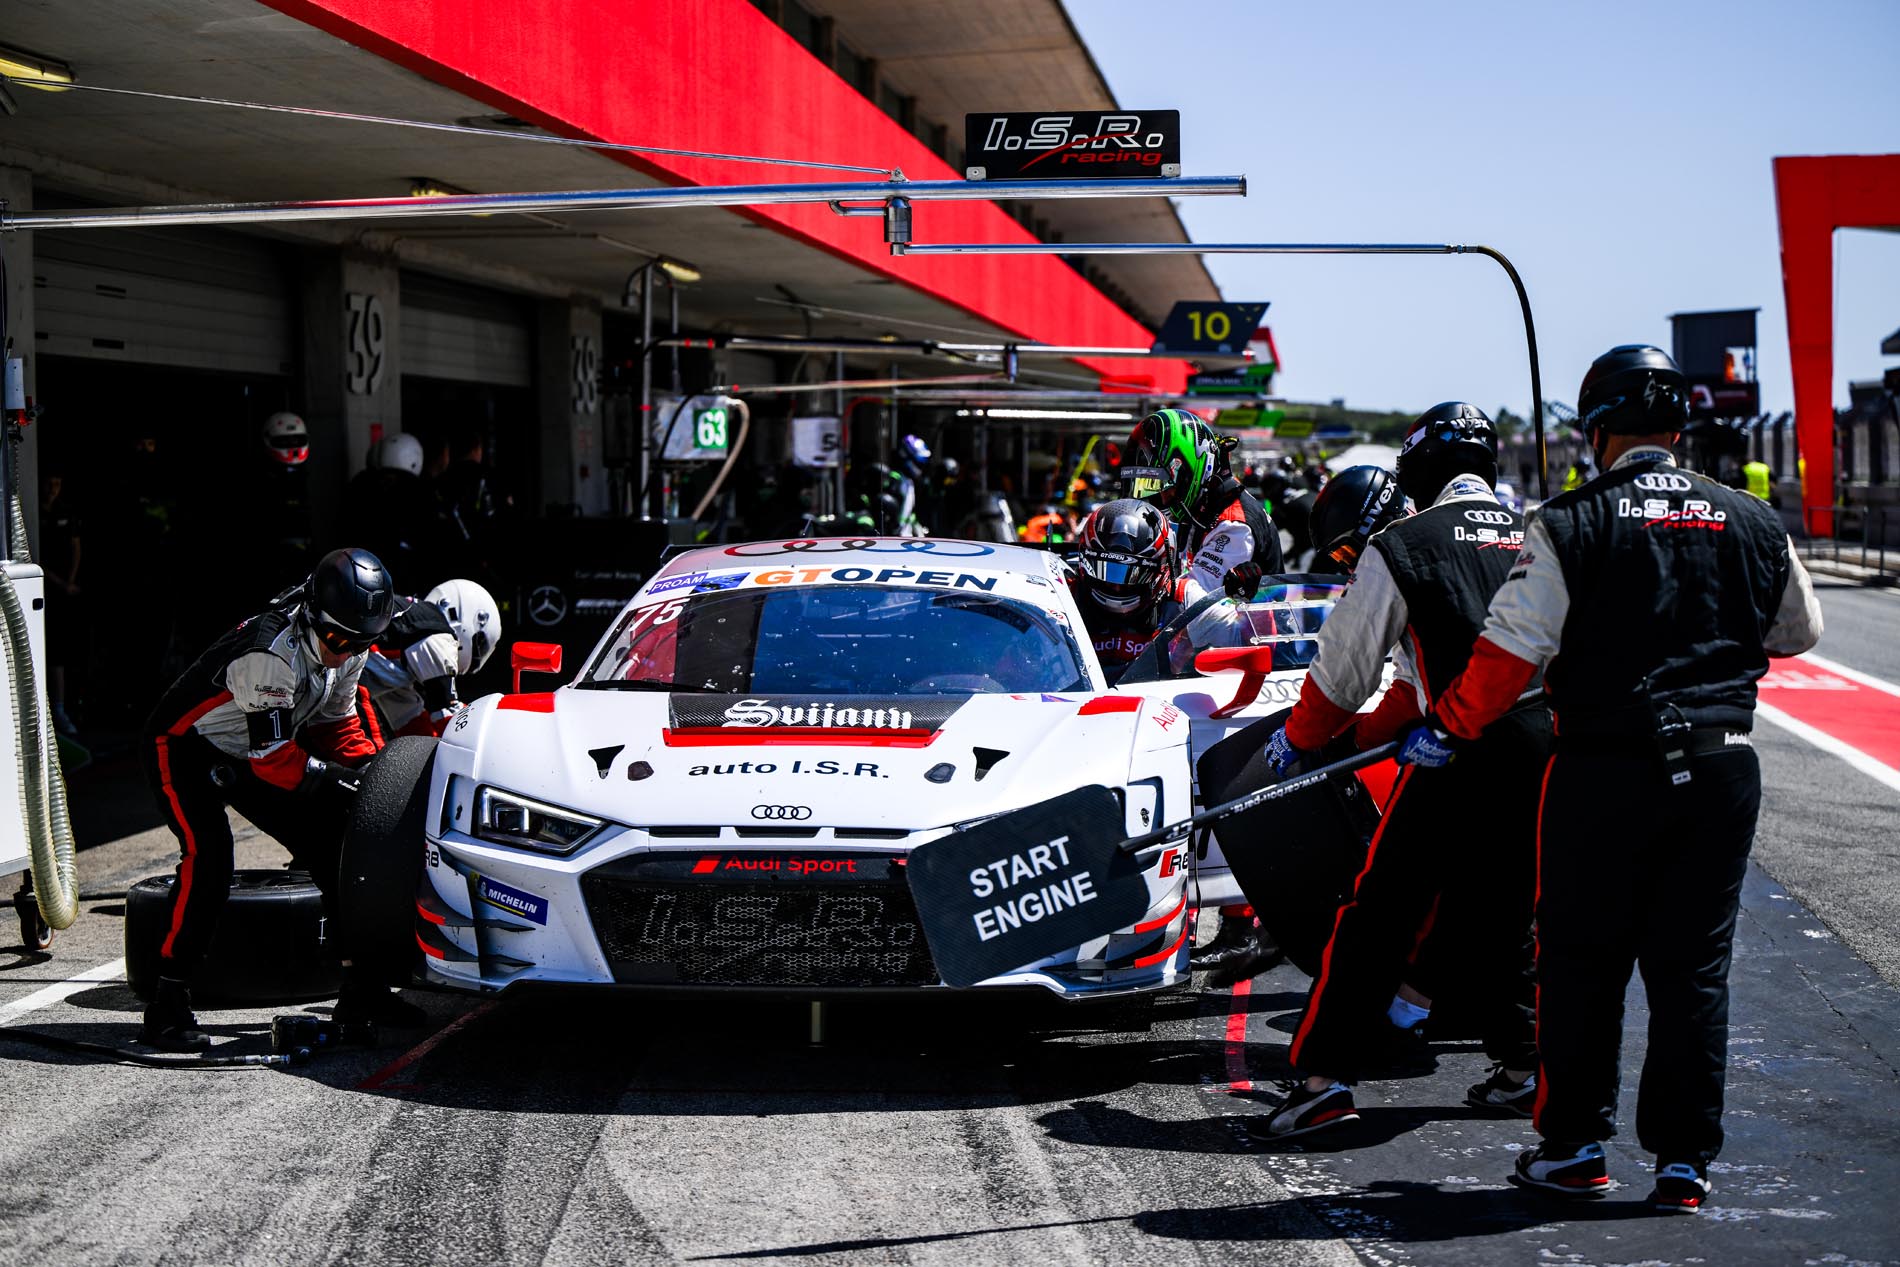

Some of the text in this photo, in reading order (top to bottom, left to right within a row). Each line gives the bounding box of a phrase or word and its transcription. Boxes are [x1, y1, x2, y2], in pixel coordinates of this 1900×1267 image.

[1060, 149, 1163, 166] racing
[1187, 310, 1231, 341] 10
[697, 410, 727, 446] 63
[1358, 477, 1399, 537] uvex
[651, 575, 705, 593] PROAM
[628, 598, 690, 632] 75
[1095, 637, 1122, 651] udi
[268, 709, 282, 739] 1
[688, 760, 889, 779] auto I.S.R.
[724, 855, 857, 875] Audi Sport
[969, 835, 1070, 898] START
[488, 888, 539, 915] MICHELIN
[973, 871, 1098, 942] ENGINE
